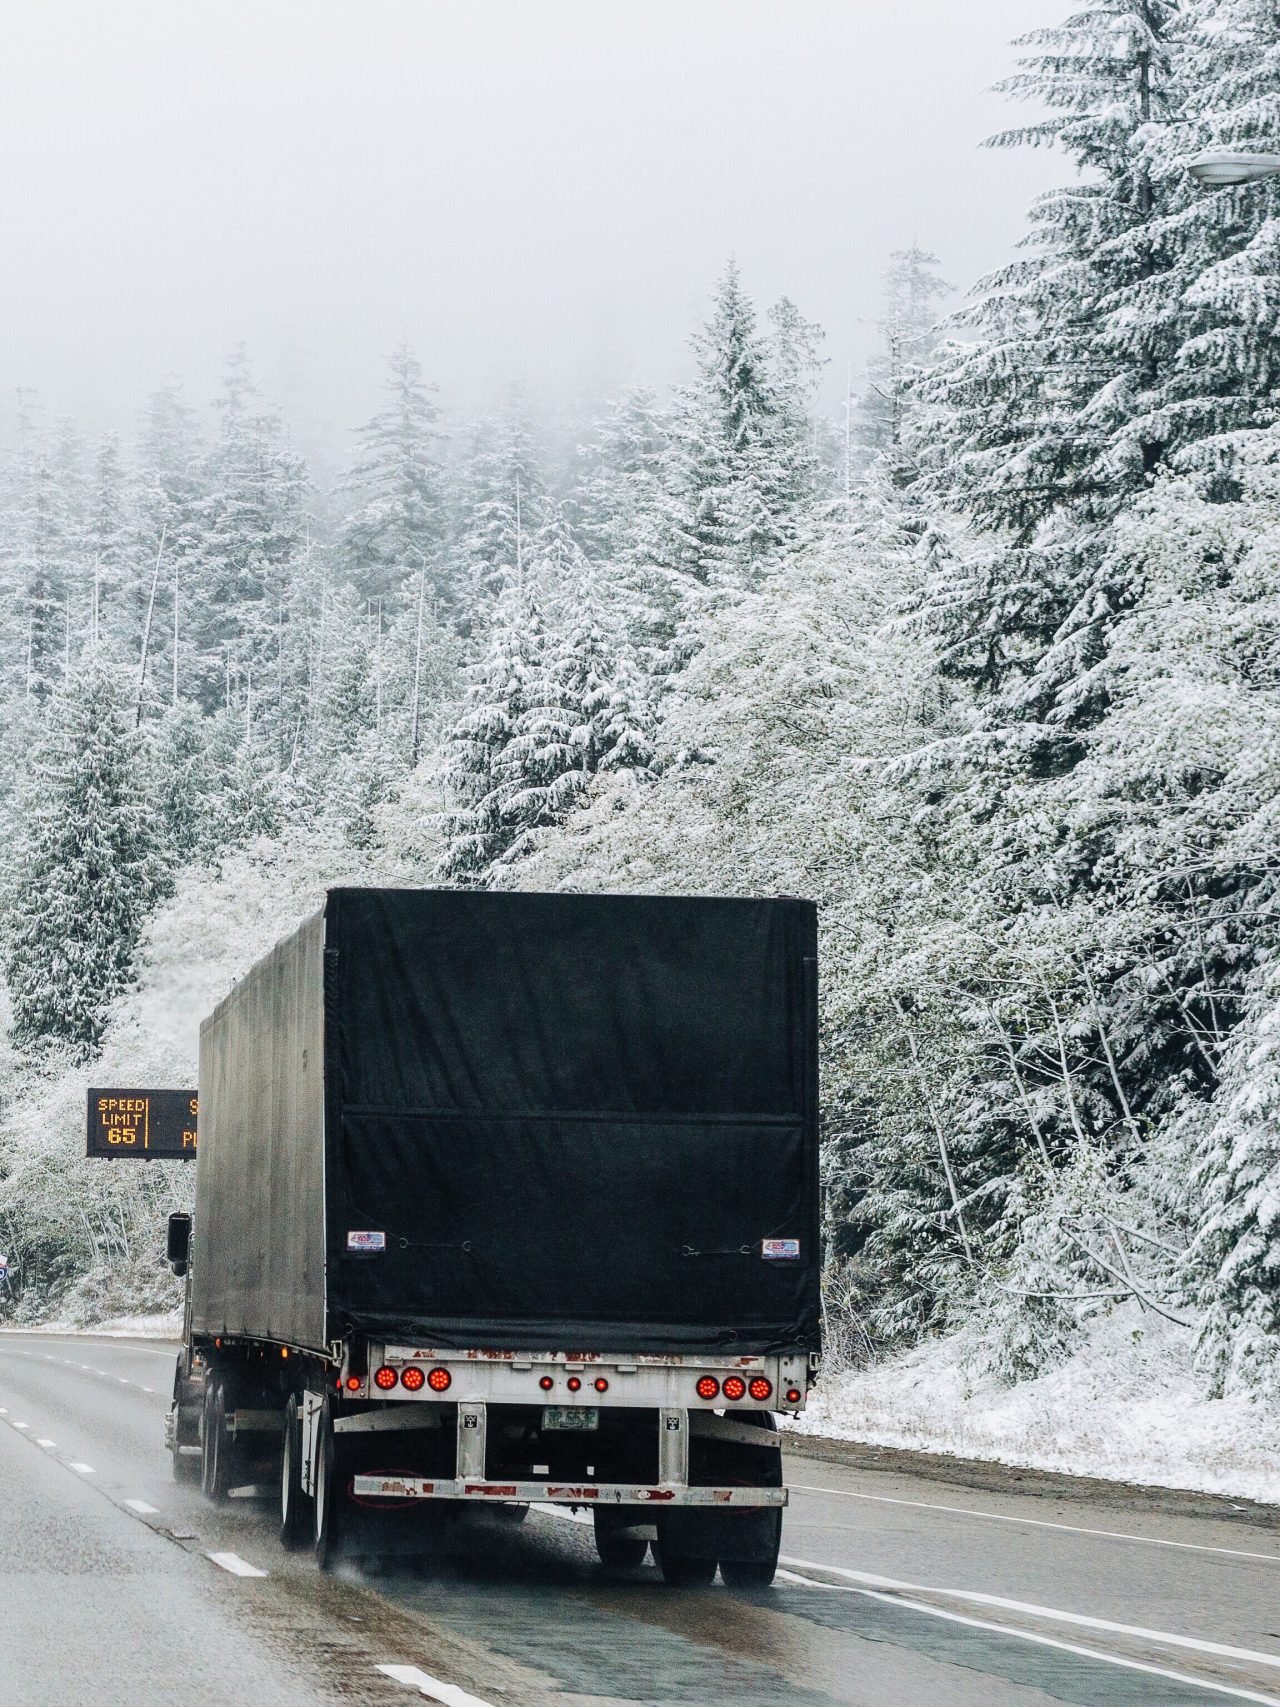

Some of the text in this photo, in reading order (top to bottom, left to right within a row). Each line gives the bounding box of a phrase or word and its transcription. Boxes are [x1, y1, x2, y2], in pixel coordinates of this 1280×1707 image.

[98, 1099, 145, 1112] SPEED
[102, 1113, 142, 1125] LIMIT
[108, 1128, 136, 1144] 65
